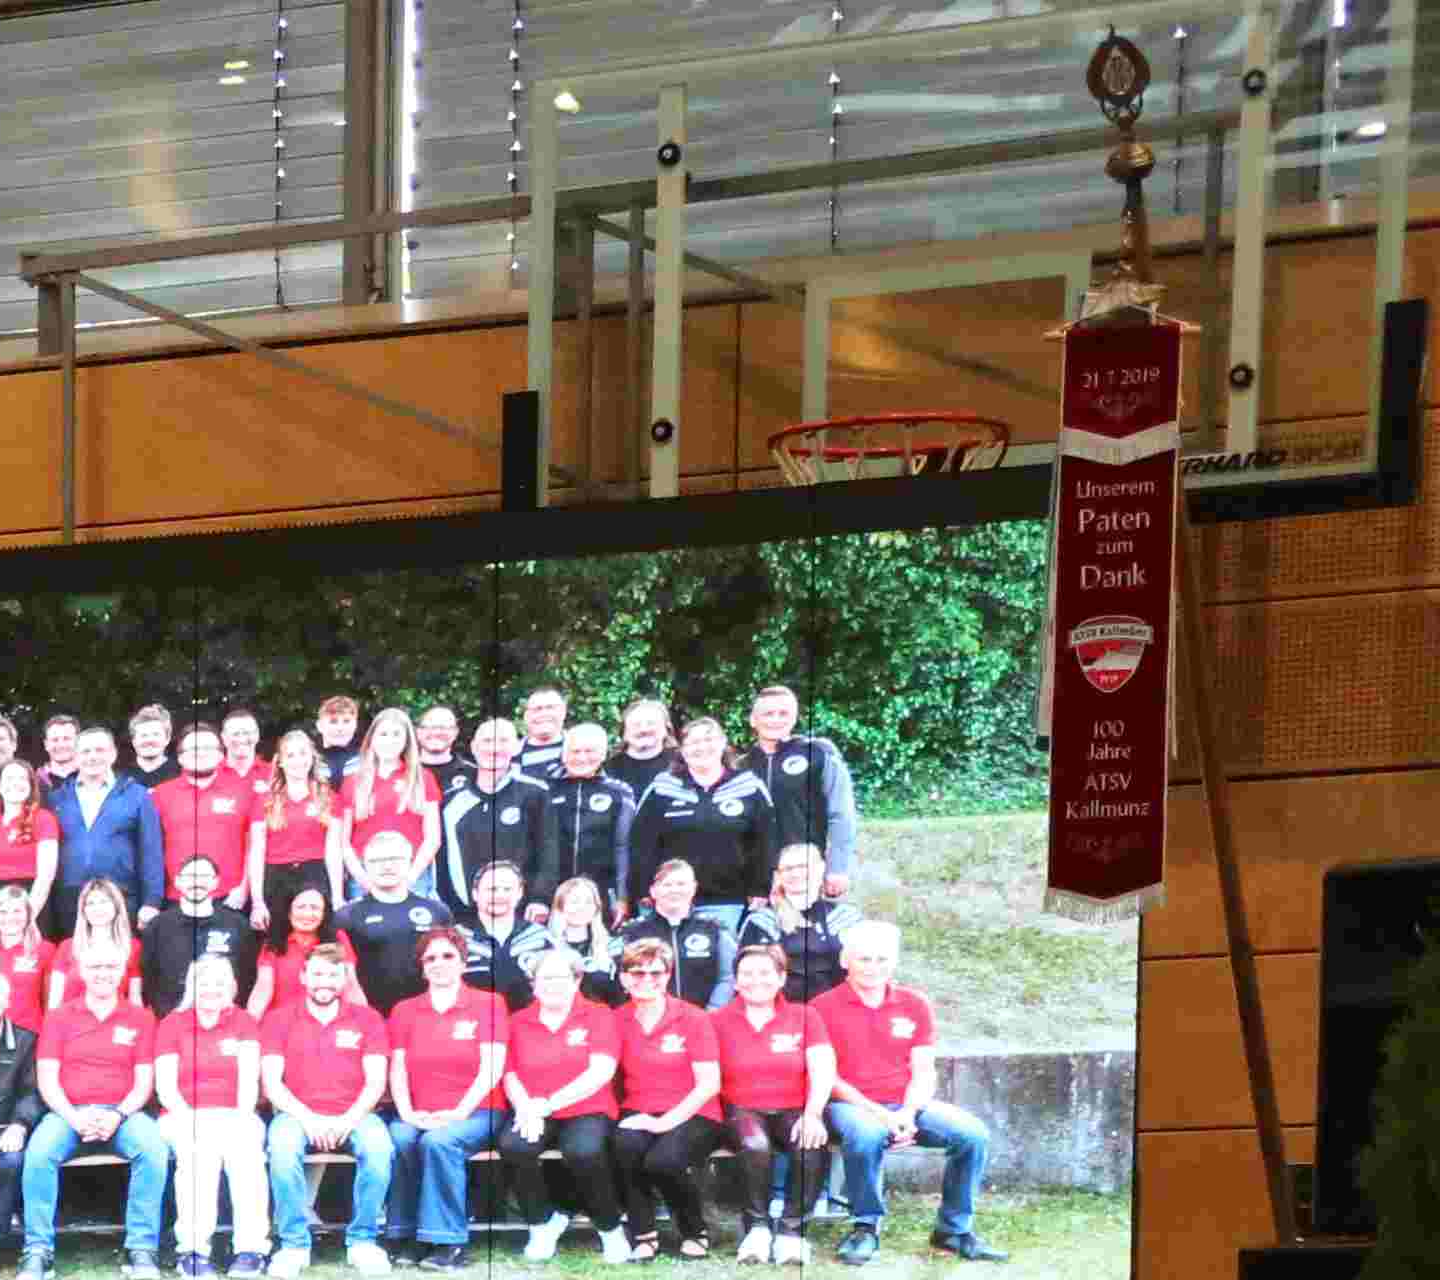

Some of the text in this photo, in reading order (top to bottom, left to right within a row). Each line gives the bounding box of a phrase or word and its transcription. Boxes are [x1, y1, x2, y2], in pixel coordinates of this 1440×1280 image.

[1077, 480, 1155, 499] Unserem
[1079, 508, 1151, 534] Paten
[1096, 540, 1134, 555] zum
[1080, 562, 1148, 590] Dank
[1093, 720, 1126, 738] 100
[1089, 743, 1131, 760] Jahre
[1084, 773, 1132, 791] ATSV
